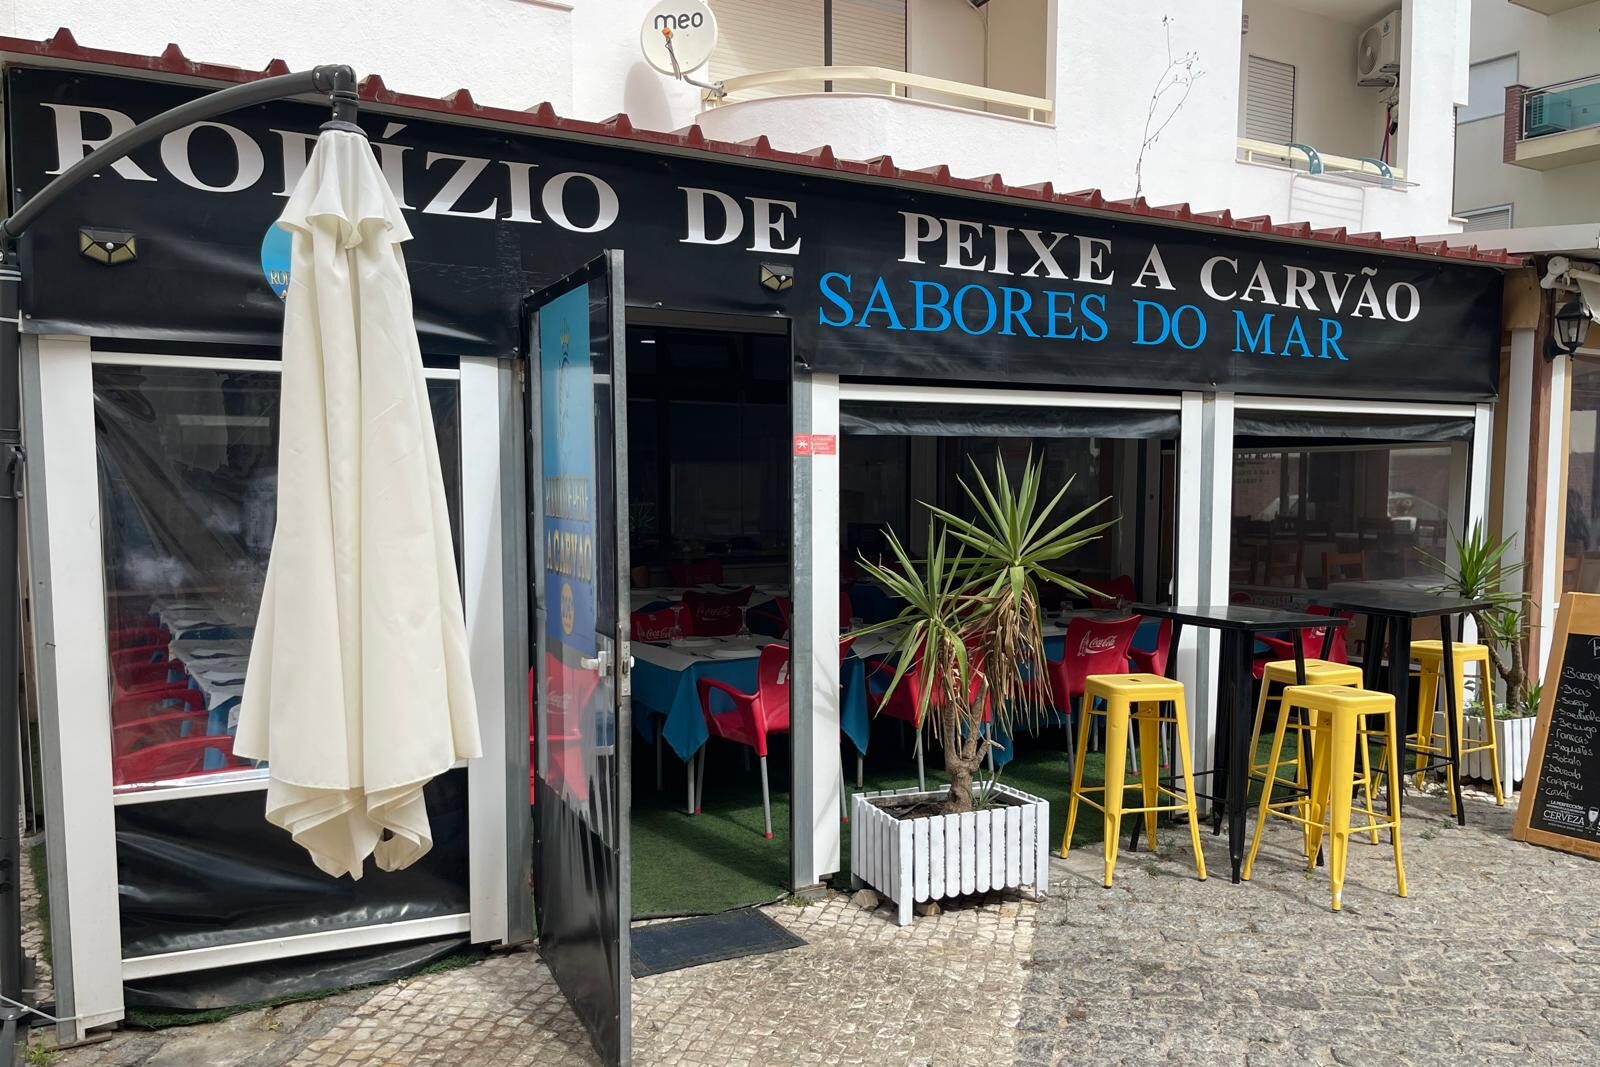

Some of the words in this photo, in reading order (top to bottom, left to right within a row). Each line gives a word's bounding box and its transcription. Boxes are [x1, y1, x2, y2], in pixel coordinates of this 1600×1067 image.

[654, 12, 704, 30] meo
[677, 186, 802, 255] DE
[897, 210, 1115, 286] PEIXE
[1131, 243, 1177, 291] A
[1200, 255, 1421, 323] CARVÃO
[818, 271, 1109, 343] SABORES
[1132, 298, 1208, 350] DO
[1232, 309, 1350, 361] MAR
[1543, 809, 1585, 826] CERVEZA
